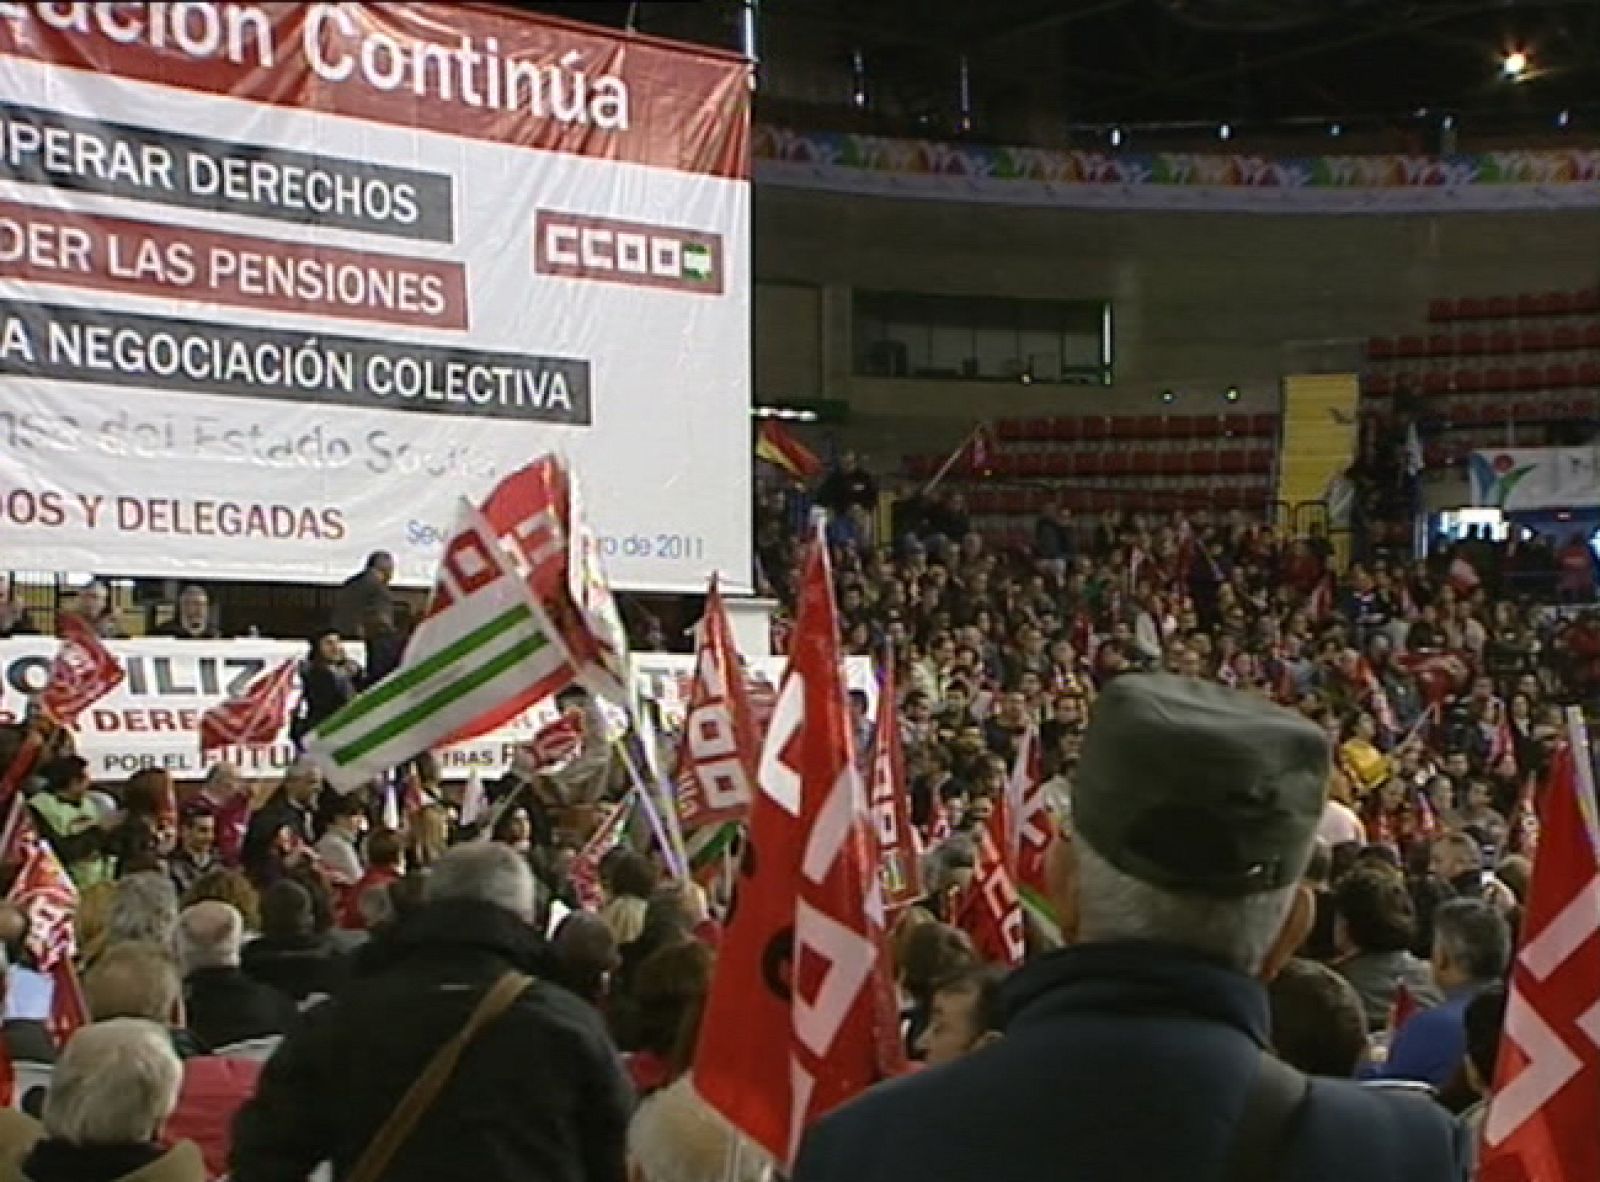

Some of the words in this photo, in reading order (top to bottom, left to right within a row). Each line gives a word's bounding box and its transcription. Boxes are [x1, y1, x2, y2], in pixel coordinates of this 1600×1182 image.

[302, 2, 630, 131] Continúa
[0, 119, 174, 190] PERAR
[186, 152, 419, 225] DERECHOS
[106, 233, 197, 285] LAS
[208, 248, 446, 316] PENSIONES
[545, 222, 682, 279] CCOO
[48, 319, 353, 392] NEGOCIACIÓN
[365, 354, 573, 410] COLECTIVA
[0, 487, 66, 525] OS
[78, 494, 103, 528] Y
[117, 495, 346, 540] DELEGADAS
[656, 533, 705, 560] 2011
